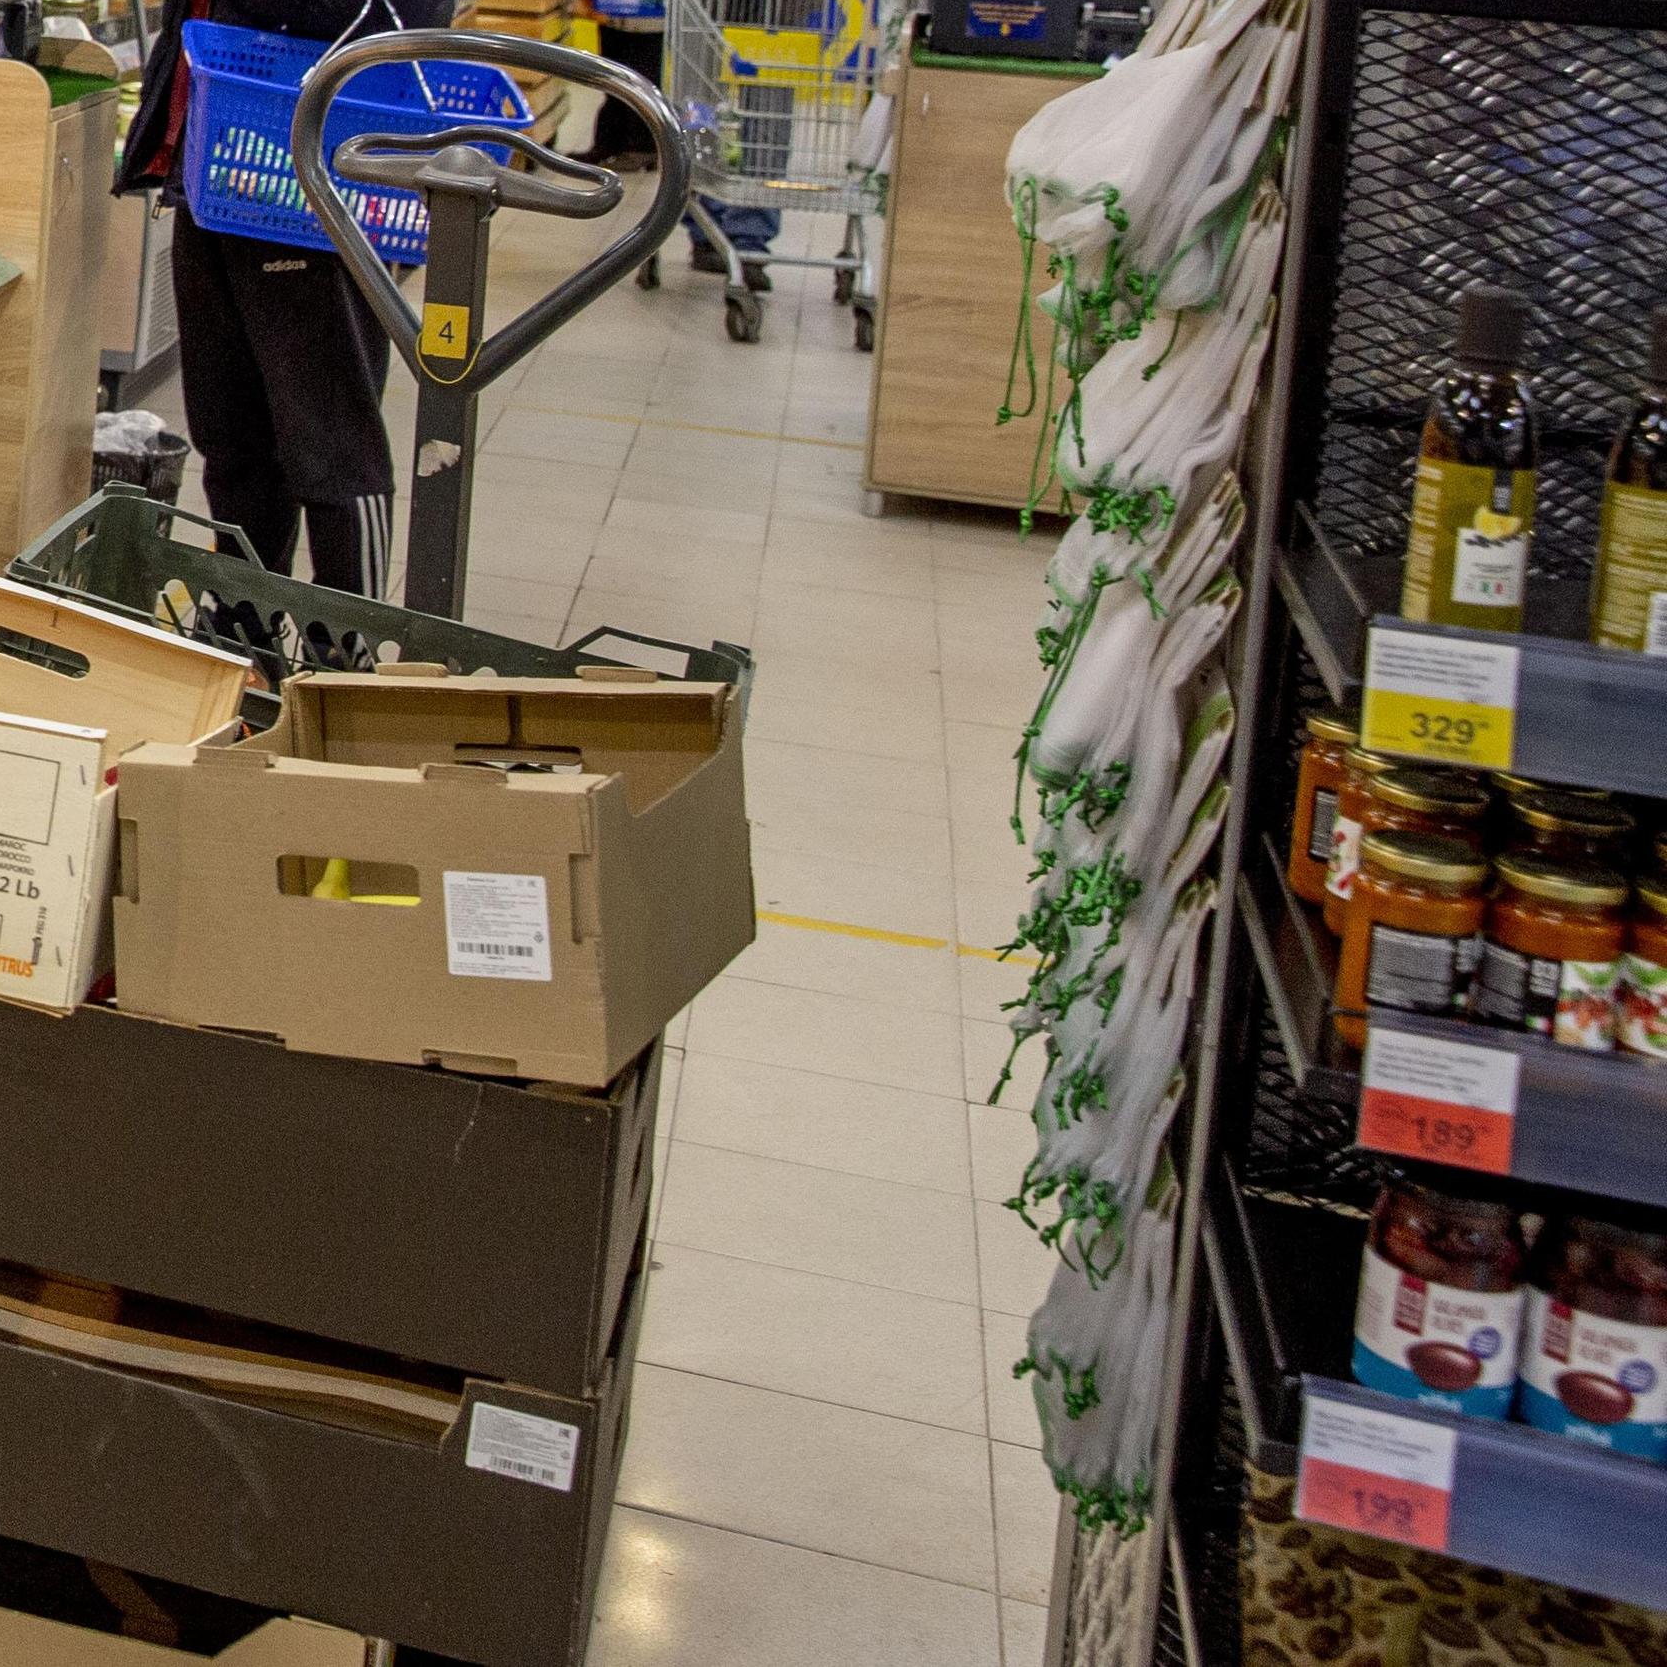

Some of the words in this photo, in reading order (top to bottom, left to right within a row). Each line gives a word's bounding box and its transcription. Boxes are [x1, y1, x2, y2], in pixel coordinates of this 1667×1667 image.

[438, 320, 455, 344] 4
[1409, 712, 1476, 745] 329
[15, 879, 41, 900] Lb
